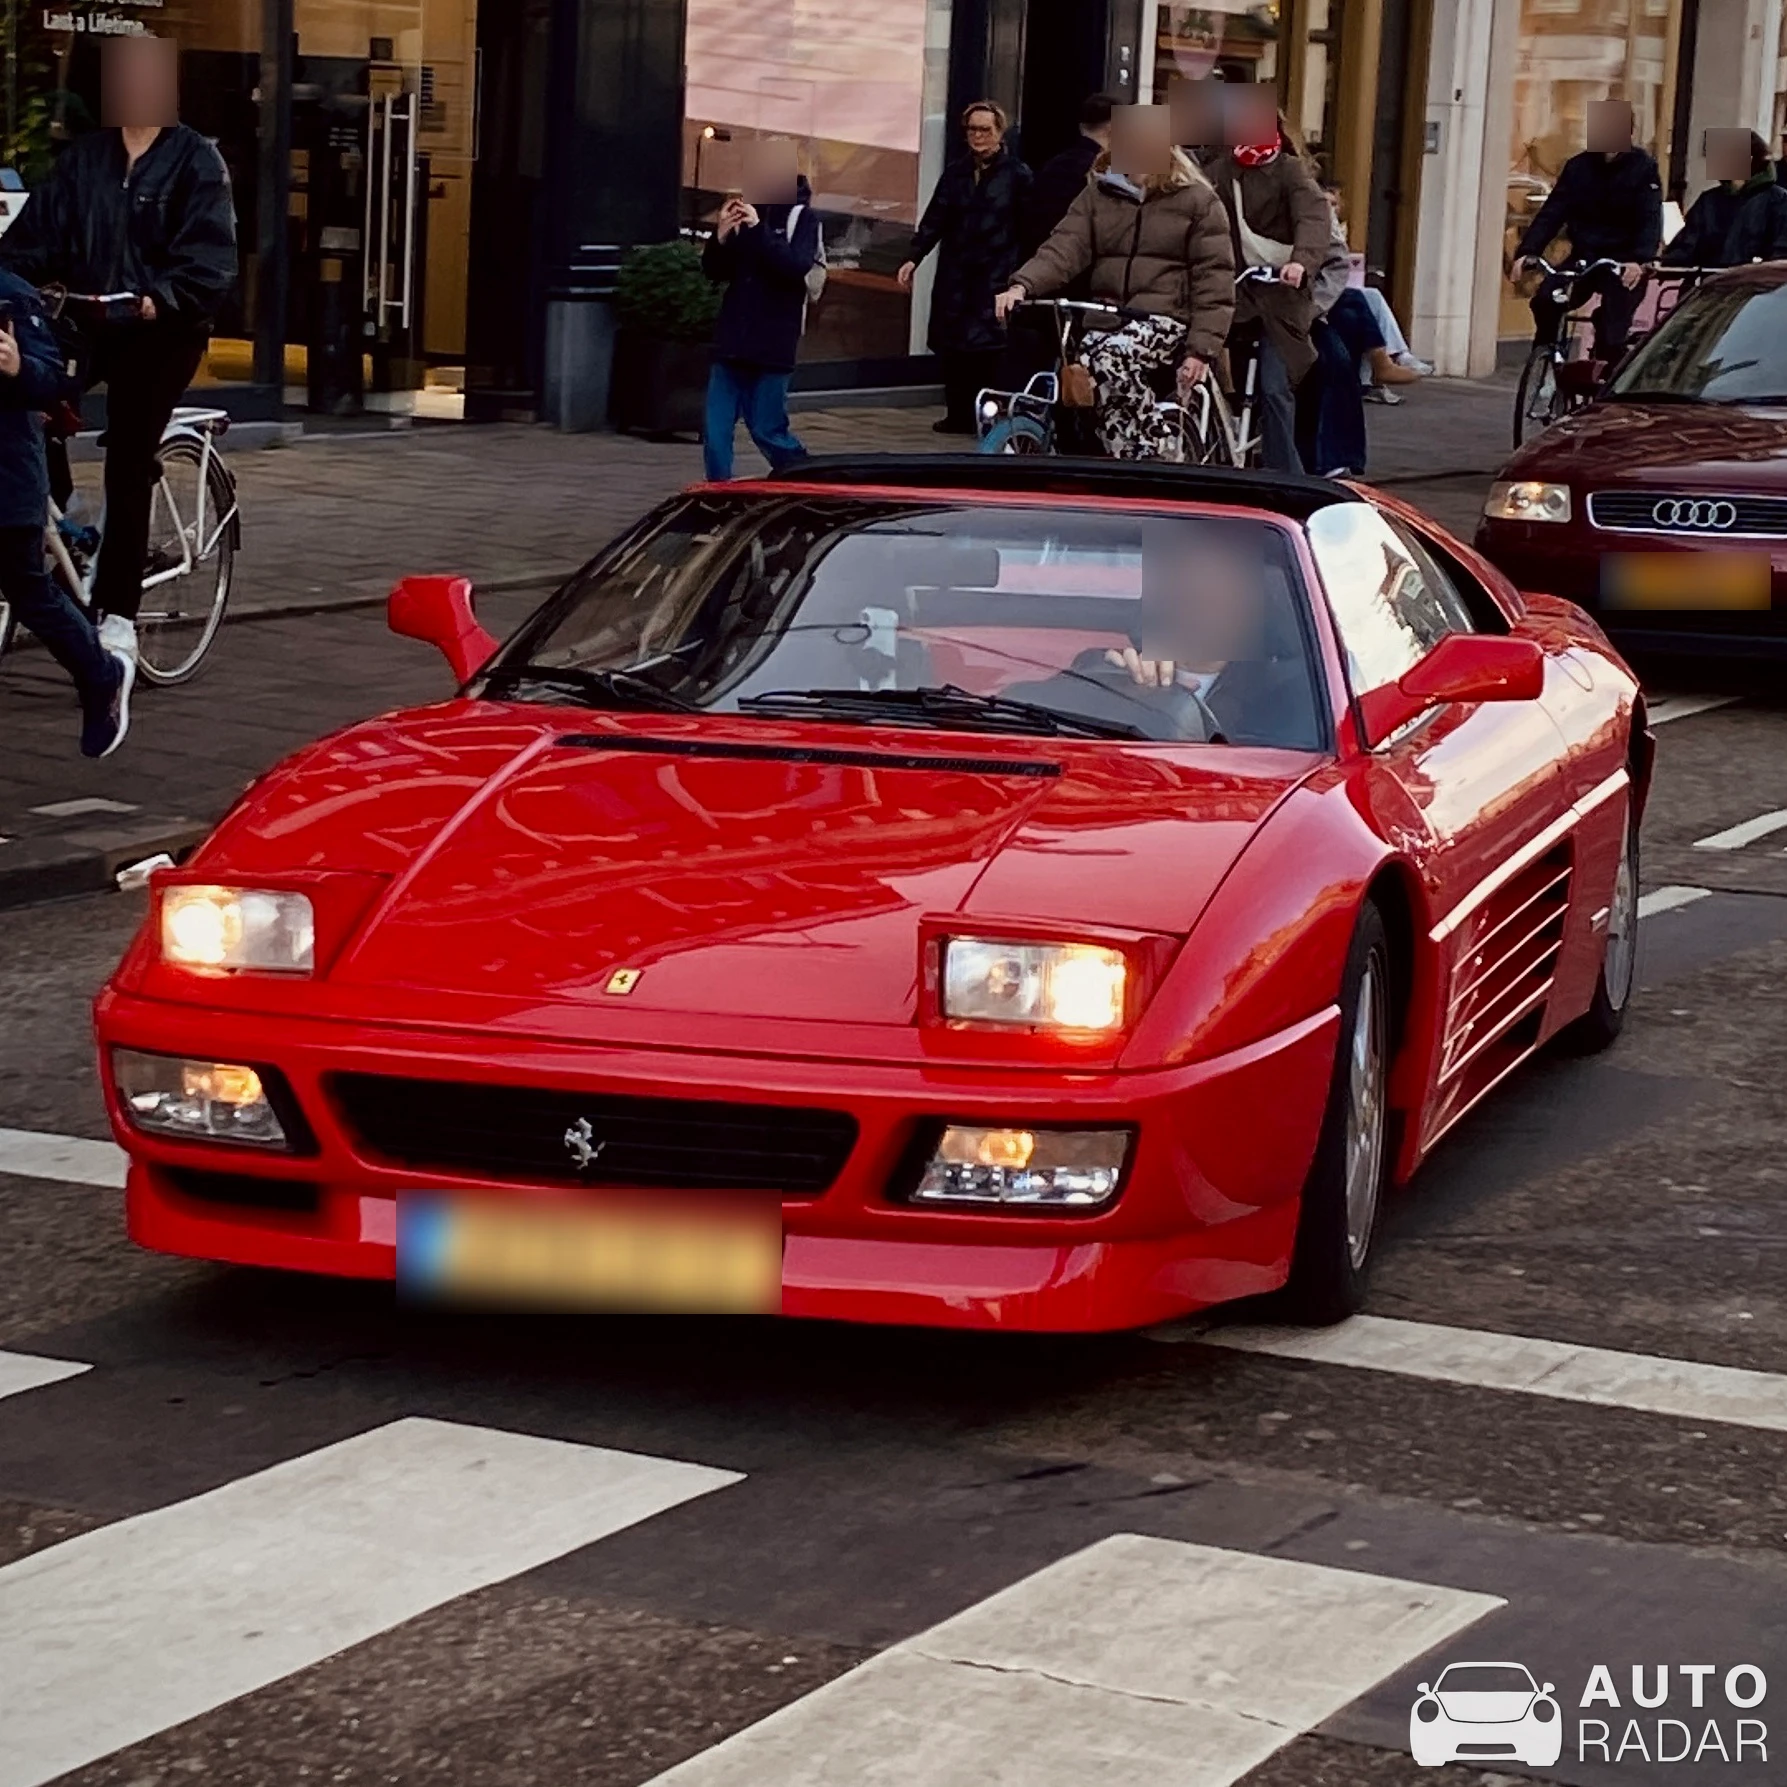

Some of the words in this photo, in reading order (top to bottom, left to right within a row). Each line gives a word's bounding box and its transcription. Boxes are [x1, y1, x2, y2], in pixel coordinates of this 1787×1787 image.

[43, 9, 75, 31] Last
[76, 16, 86, 32] a
[88, 13, 145, 35] Lifetime
